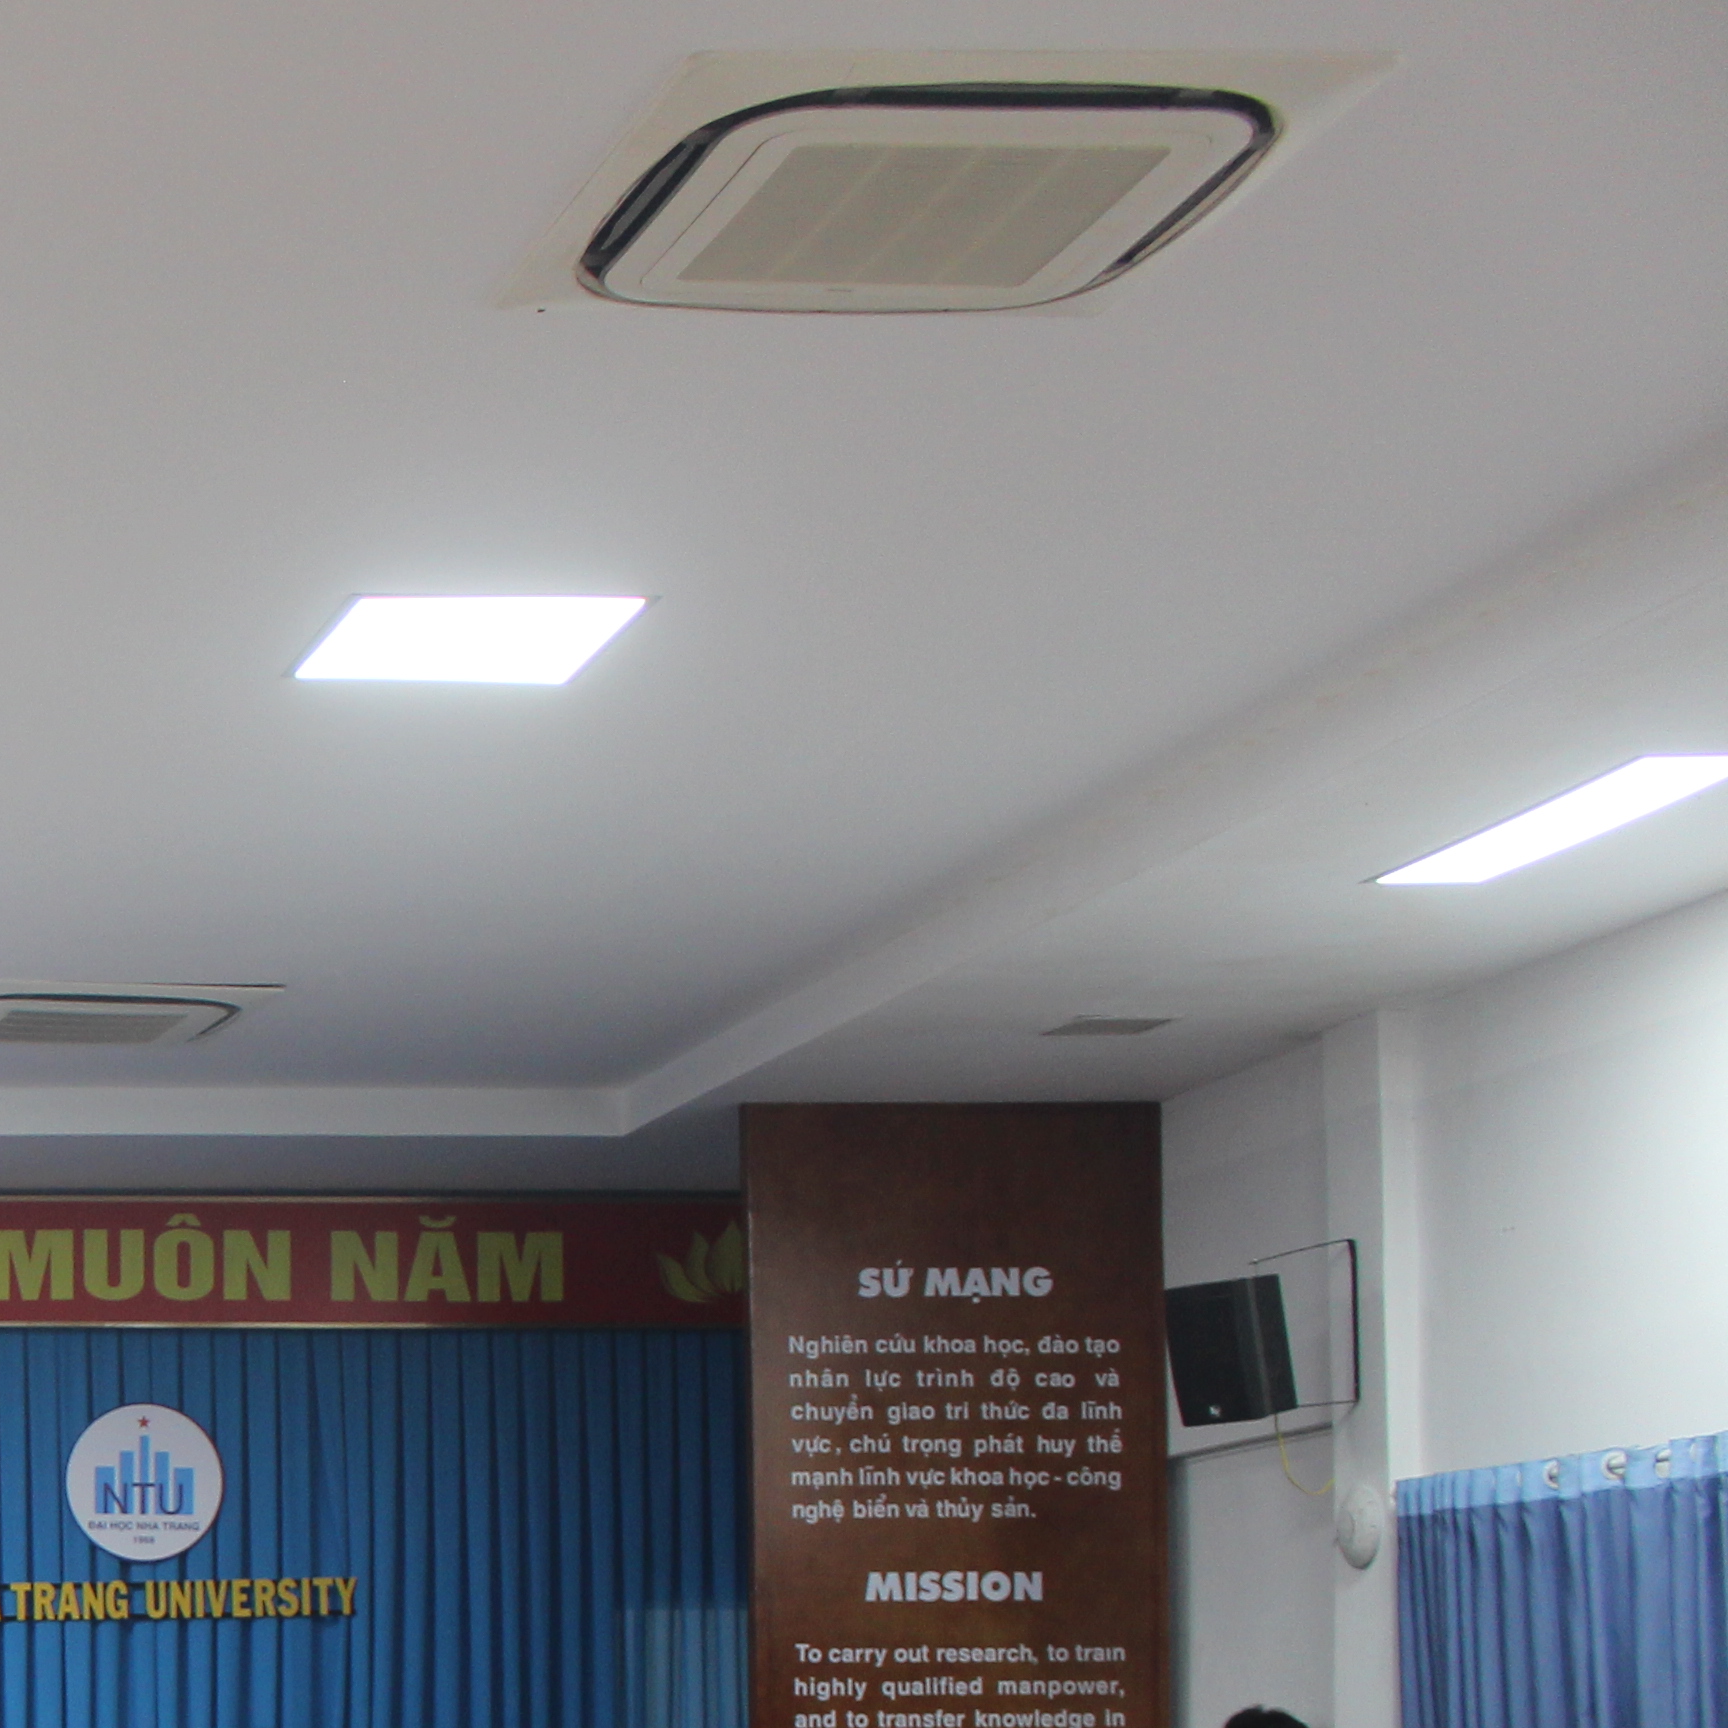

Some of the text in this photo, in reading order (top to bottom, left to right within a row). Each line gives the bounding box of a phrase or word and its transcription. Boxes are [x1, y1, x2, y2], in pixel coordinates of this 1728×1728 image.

[328, 1214, 565, 1304] NĂM
[858, 1260, 1054, 1303] SỨ MẠNG
[788, 1333, 1120, 1359] Nghiên cứu khoa học, đào tạo
[789, 1367, 1120, 1392] nhân lực trình độ cao và
[790, 1392, 873, 1425] chuyển
[887, 1402, 935, 1425] giao
[980, 1399, 1030, 1420] thức
[1042, 1402, 1069, 1420] đa
[1080, 1401, 1122, 1420] lĩnh
[849, 1432, 891, 1453] chú
[902, 1435, 962, 1458] trọng
[973, 1432, 1024, 1458] phát
[1037, 1435, 1076, 1458] huy
[1087, 1428, 1123, 1453] thế
[791, 1466, 853, 1491] mạnh
[859, 1465, 900, 1486] lĩnh
[905, 1467, 945, 1490] vực
[950, 1467, 1004, 1486] khoa
[1009, 1467, 1049, 1491] học
[1066, 1465, 1122, 1491] công
[103, 1482, 184, 1515] NTU
[792, 1500, 844, 1525] nghệ
[852, 1492, 899, 1518] biển
[904, 1498, 930, 1518] và
[935, 1495, 984, 1523] thủy
[163, 1521, 200, 1532] TRANG
[10, 1579, 130, 1621] TRANG
[145, 1576, 358, 1619] UNIVERSITY
[864, 1570, 1044, 1602] MISSION
[794, 1643, 1126, 1668] To carry out research, to train
[794, 1676, 1126, 1701] highly qualified manpower,
[794, 1709, 837, 1728] and
[846, 1711, 869, 1728] to
[877, 1709, 966, 1728] transfer
[1103, 1708, 1126, 1728] in
